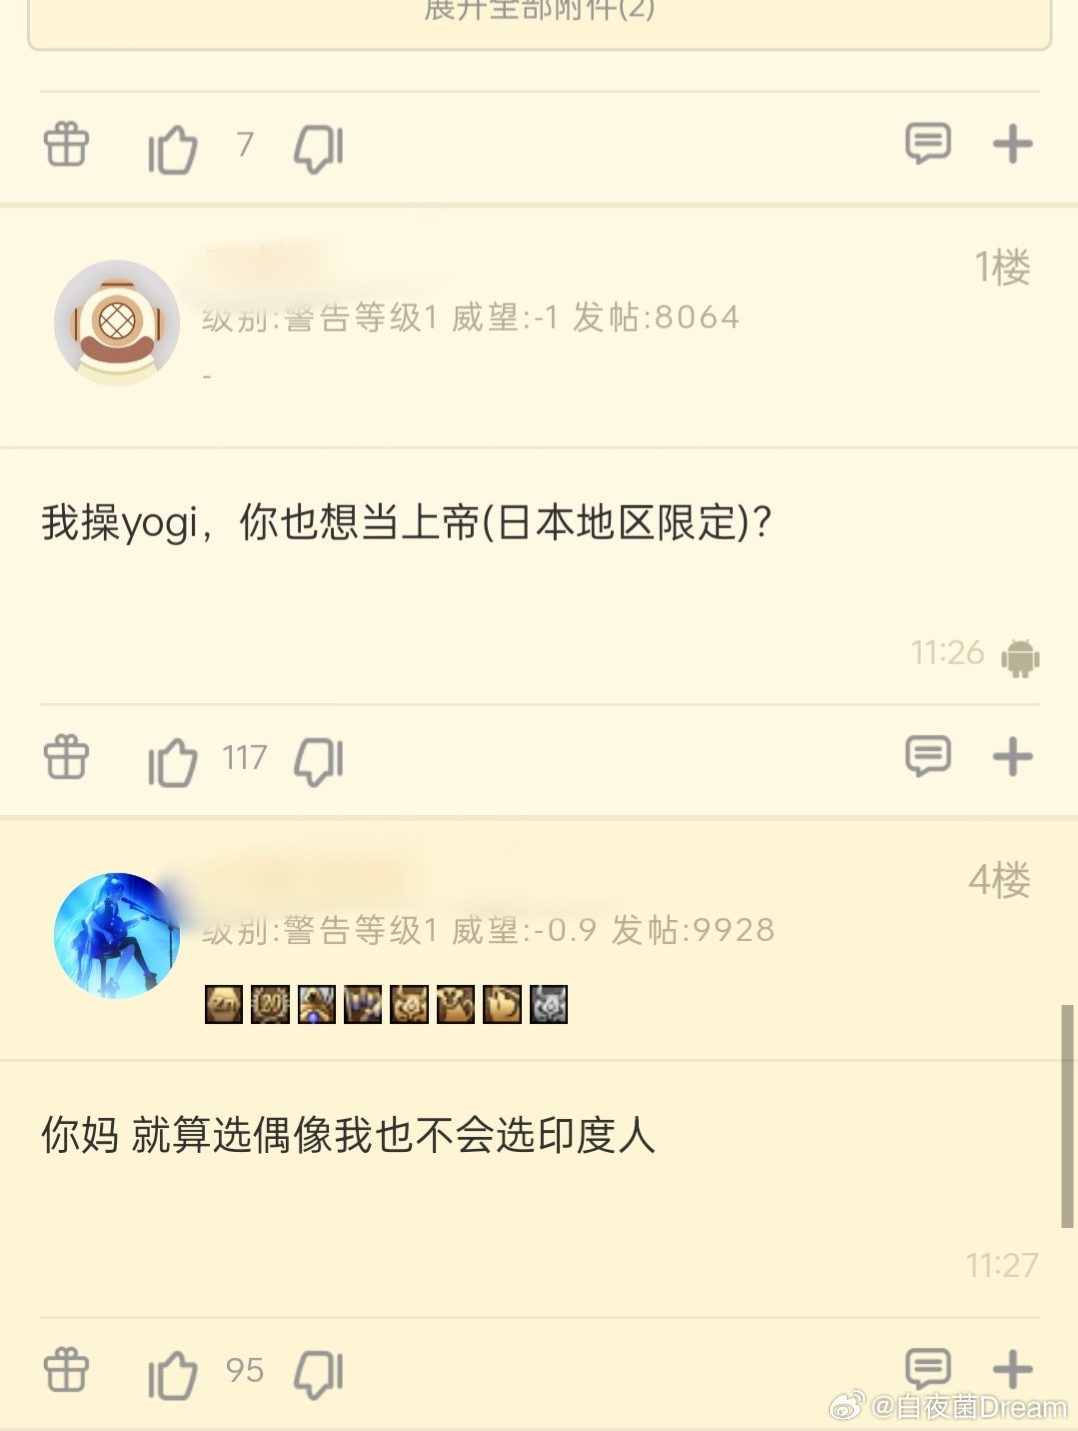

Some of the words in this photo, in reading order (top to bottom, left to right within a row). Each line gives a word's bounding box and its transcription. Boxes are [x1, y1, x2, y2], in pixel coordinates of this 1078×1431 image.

[237, 132, 254, 156] 7
[976, 248, 1030, 286] 1楼
[202, 301, 437, 333] 级别:警告等级1
[453, 301, 558, 332] 威望:-1
[574, 301, 739, 332] 发帖:8064
[911, 640, 985, 665] 11:26
[222, 745, 267, 769] 117
[969, 861, 1030, 899] 4楼
[202, 913, 437, 945] 级别:警告等级1
[453, 914, 597, 944] 威望:-0.9
[612, 914, 775, 945] 发帖:9928
[41, 1115, 118, 1154] 你妈
[132, 1115, 656, 1154] 就算选偶像我也不会选印度人
[966, 1253, 1039, 1278] 11:27
[226, 1358, 264, 1383] 95
